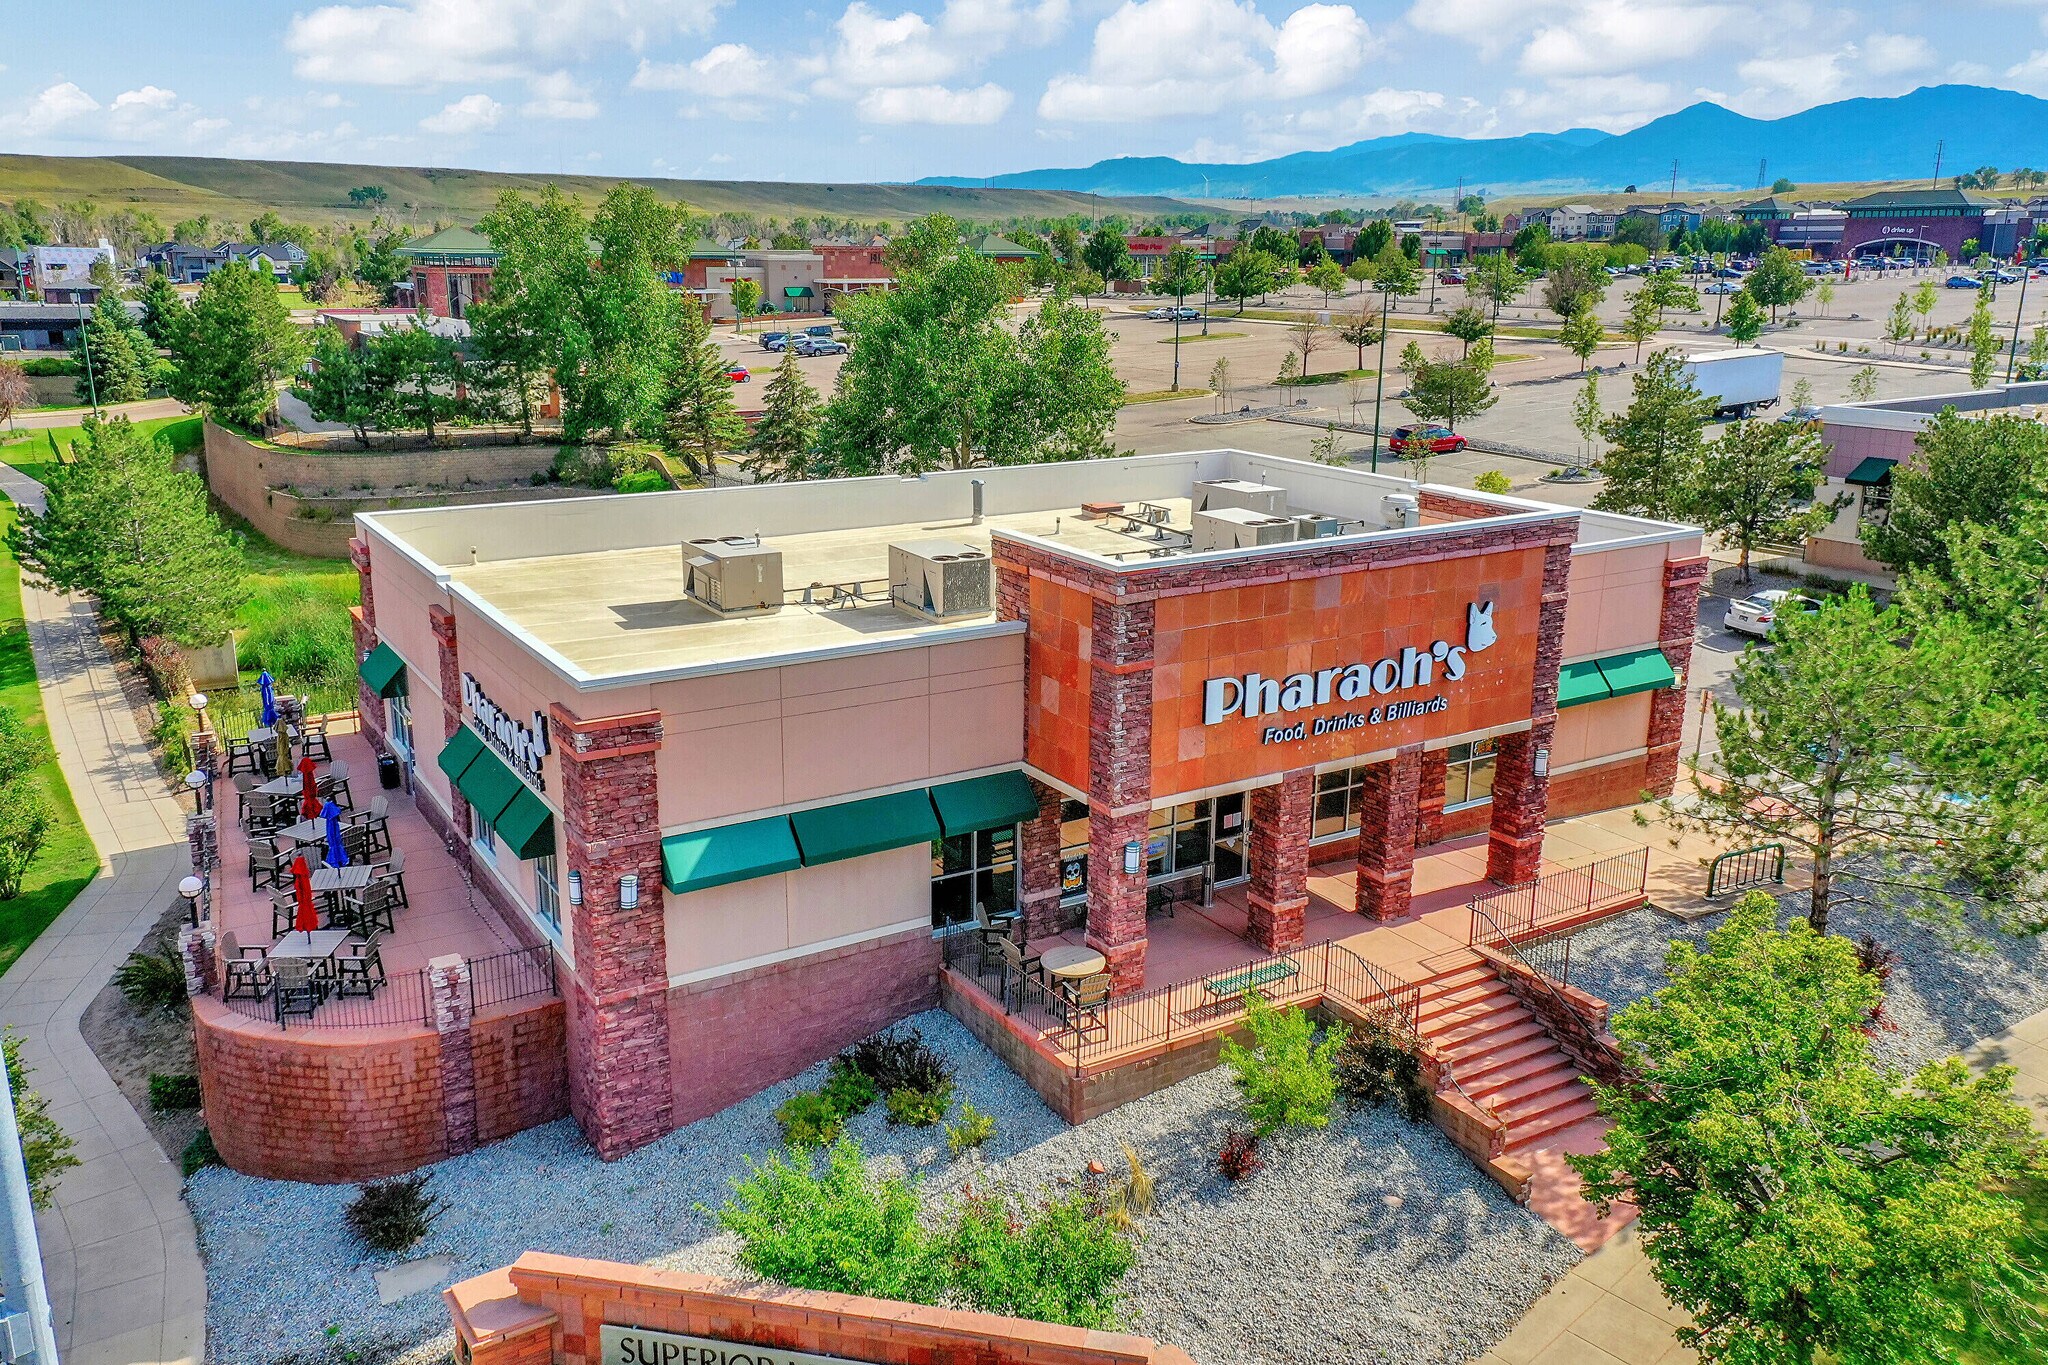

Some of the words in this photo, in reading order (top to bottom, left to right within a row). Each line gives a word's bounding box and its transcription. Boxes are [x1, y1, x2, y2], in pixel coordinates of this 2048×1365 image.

[1203, 640, 1467, 725] Pharaoh's
[1264, 722, 1308, 745] Food,
[1313, 713, 1365, 735] Drinks
[1369, 707, 1382, 725] &
[1386, 695, 1448, 721] Billiards
